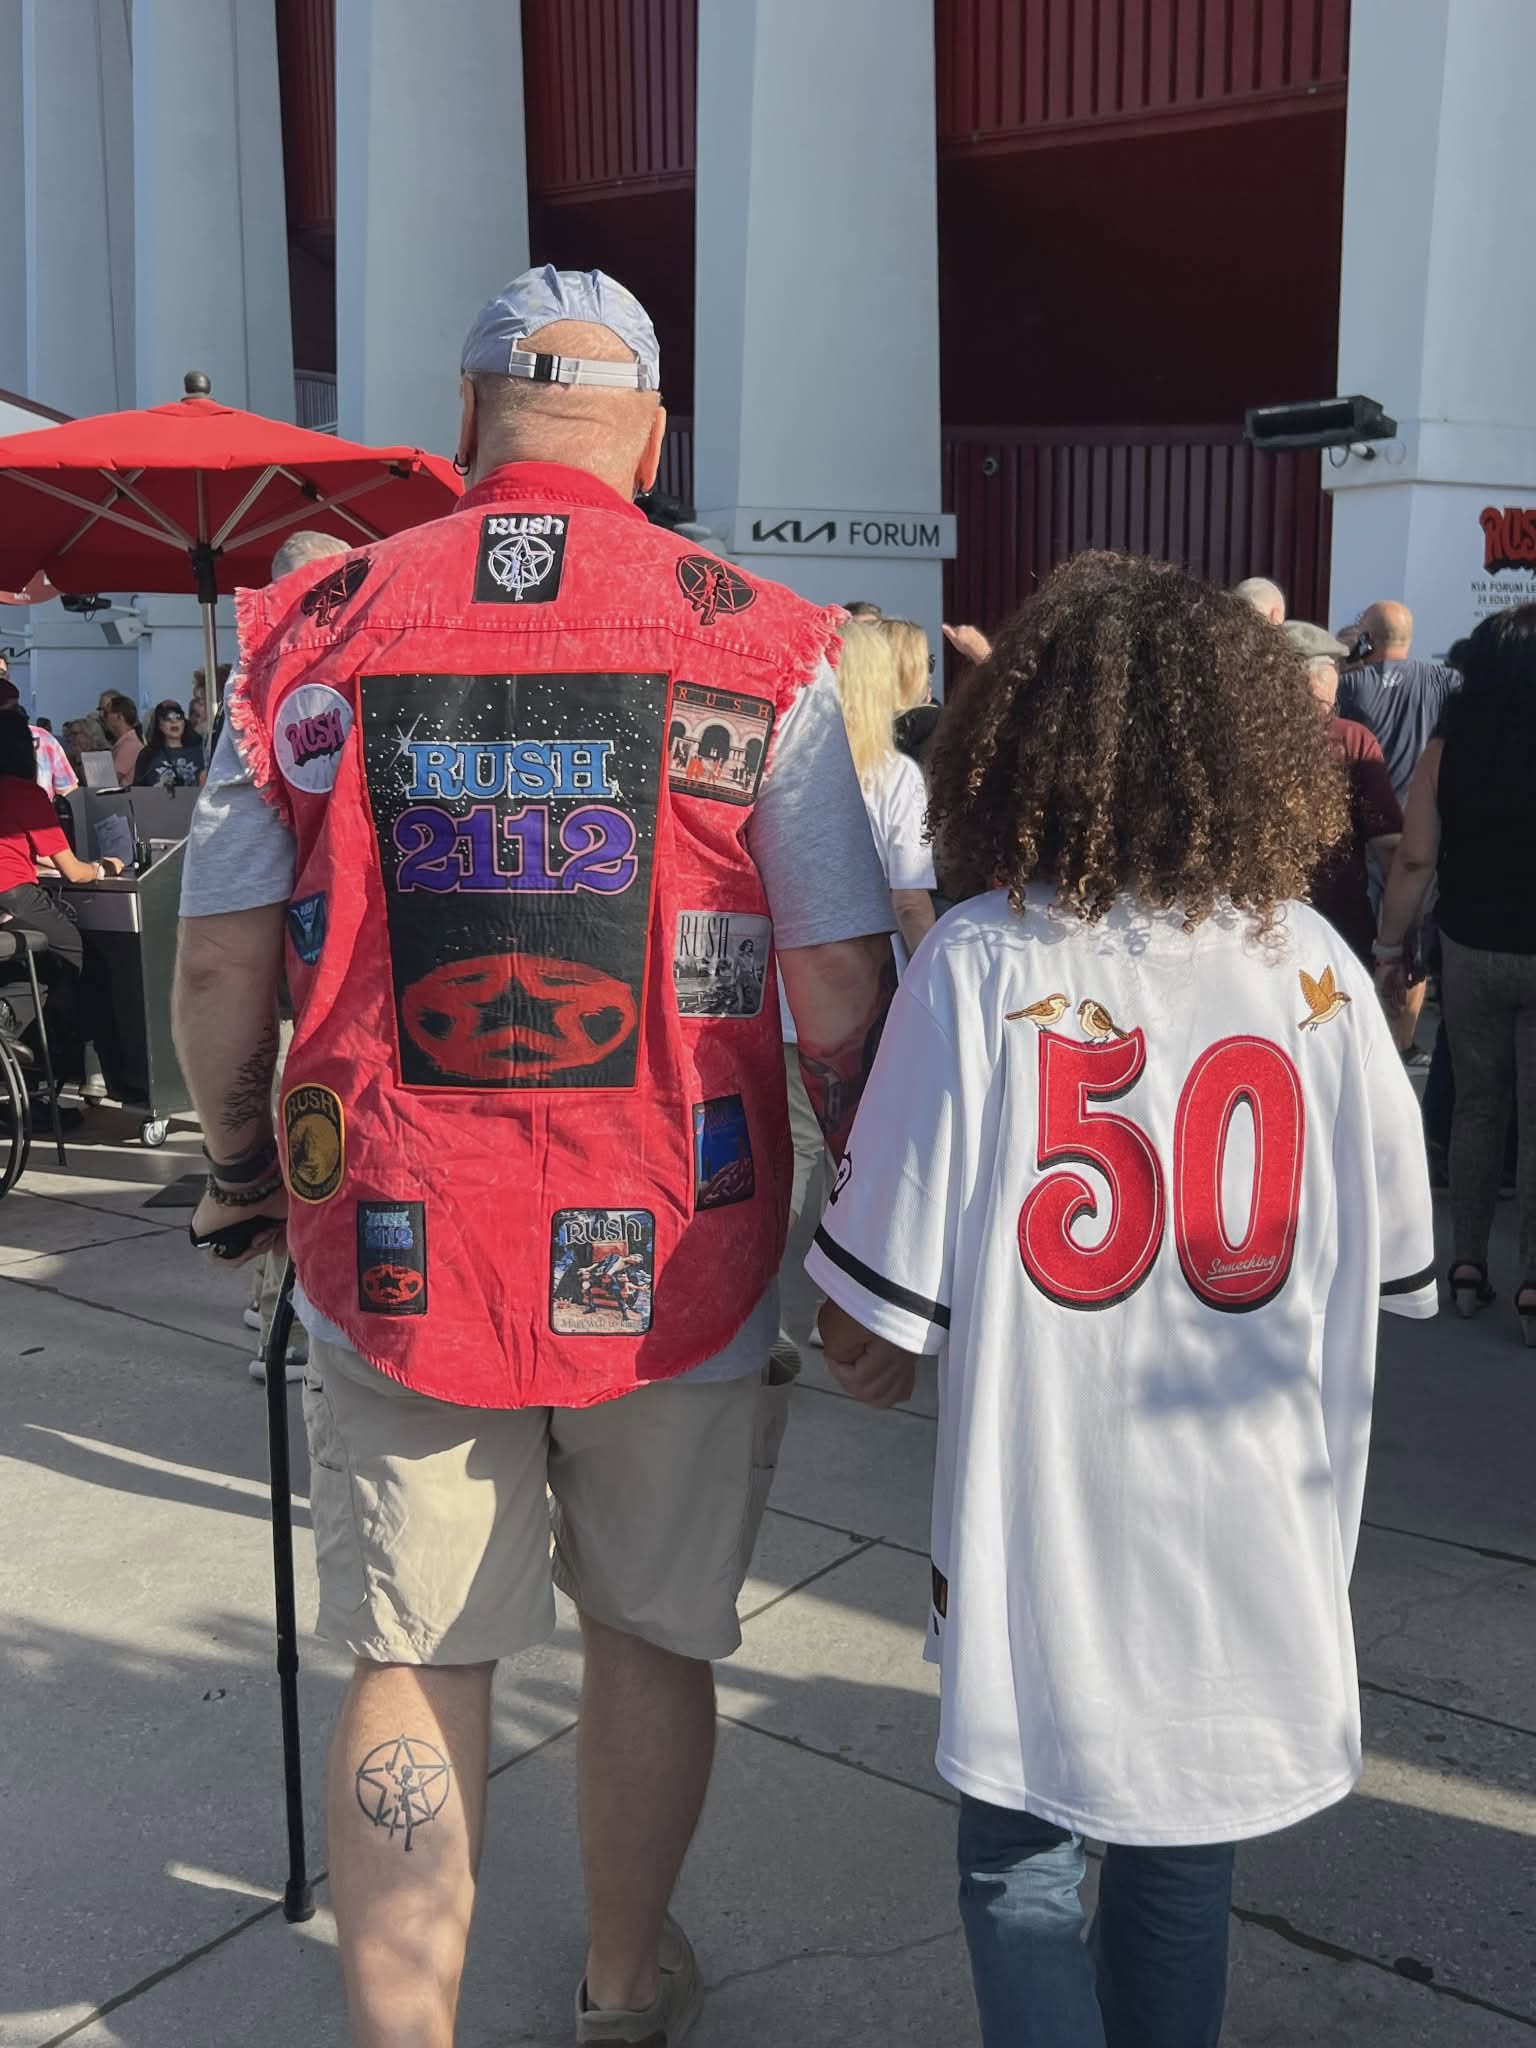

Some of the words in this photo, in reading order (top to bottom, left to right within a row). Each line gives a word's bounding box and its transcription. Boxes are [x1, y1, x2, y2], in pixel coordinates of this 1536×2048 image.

[752, 519, 837, 544] KIA
[849, 521, 940, 548] FORUM
[1490, 582, 1523, 593] FORUM
[285, 707, 345, 767] RUSH
[403, 739, 616, 799] RUSH
[393, 804, 638, 896] 2112
[680, 915, 729, 959] RUSH
[287, 1089, 338, 1126] RUSH
[1017, 1026, 1306, 1314] 50
